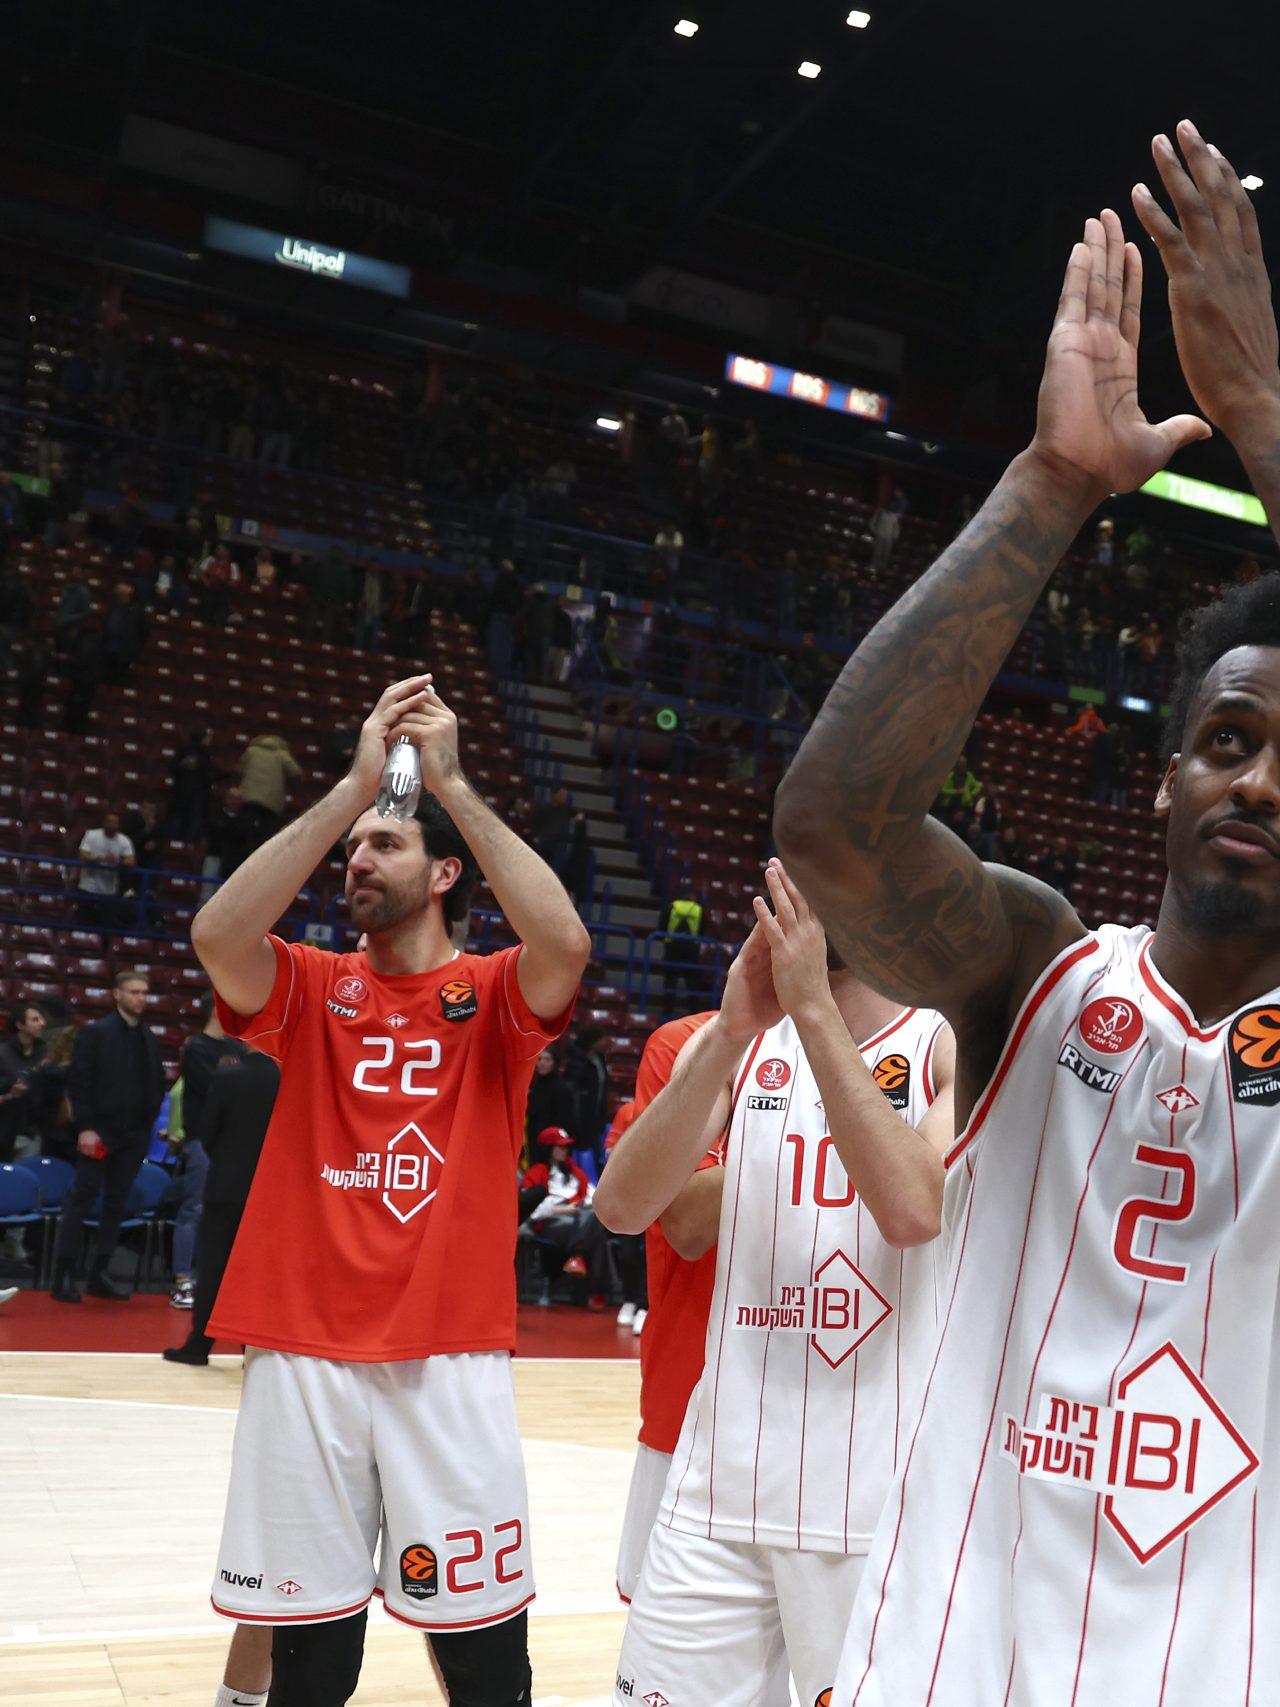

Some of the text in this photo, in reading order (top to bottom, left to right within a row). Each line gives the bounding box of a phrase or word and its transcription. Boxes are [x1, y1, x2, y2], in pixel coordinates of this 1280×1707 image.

[282, 238, 345, 273] Unipol
[352, 1036, 442, 1096] 22
[1060, 1045, 1121, 1091] RTMI
[748, 1097, 787, 1110] RTMI
[1238, 1086, 1264, 1098] abu
[356, 1152, 381, 1170] בית
[384, 1153, 430, 1191] IBI
[786, 1134, 856, 1208] 10
[1113, 1144, 1196, 1283] 2
[780, 1286, 806, 1305] בית
[812, 1287, 860, 1330] IBI
[736, 1306, 805, 1330] השקעות
[1045, 1397, 1099, 1441] בית
[1107, 1411, 1201, 1494] IBI
[445, 1519, 524, 1594] 22
[220, 1569, 264, 1590] nuvei
